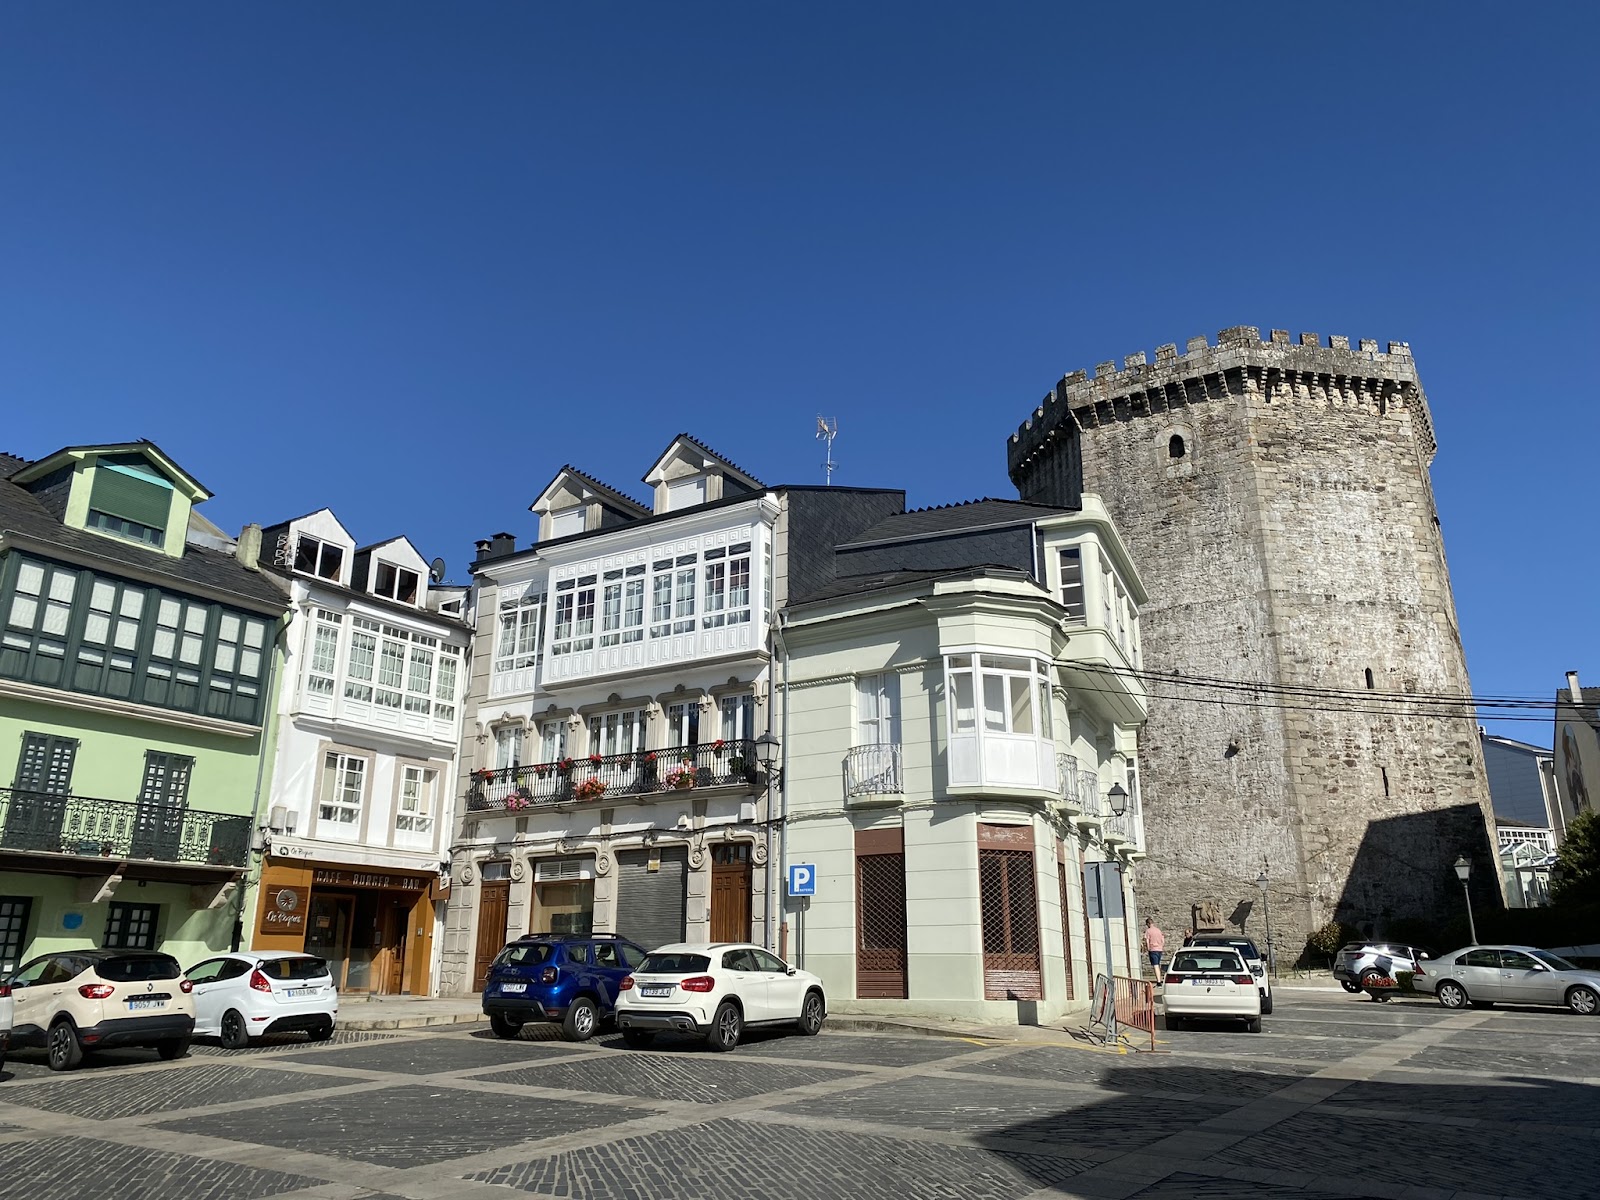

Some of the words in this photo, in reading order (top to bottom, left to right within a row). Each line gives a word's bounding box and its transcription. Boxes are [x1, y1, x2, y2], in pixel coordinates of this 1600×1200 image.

[352, 873, 390, 888] BURGER
[402, 878, 420, 890] BAR
[794, 868, 810, 892] P
